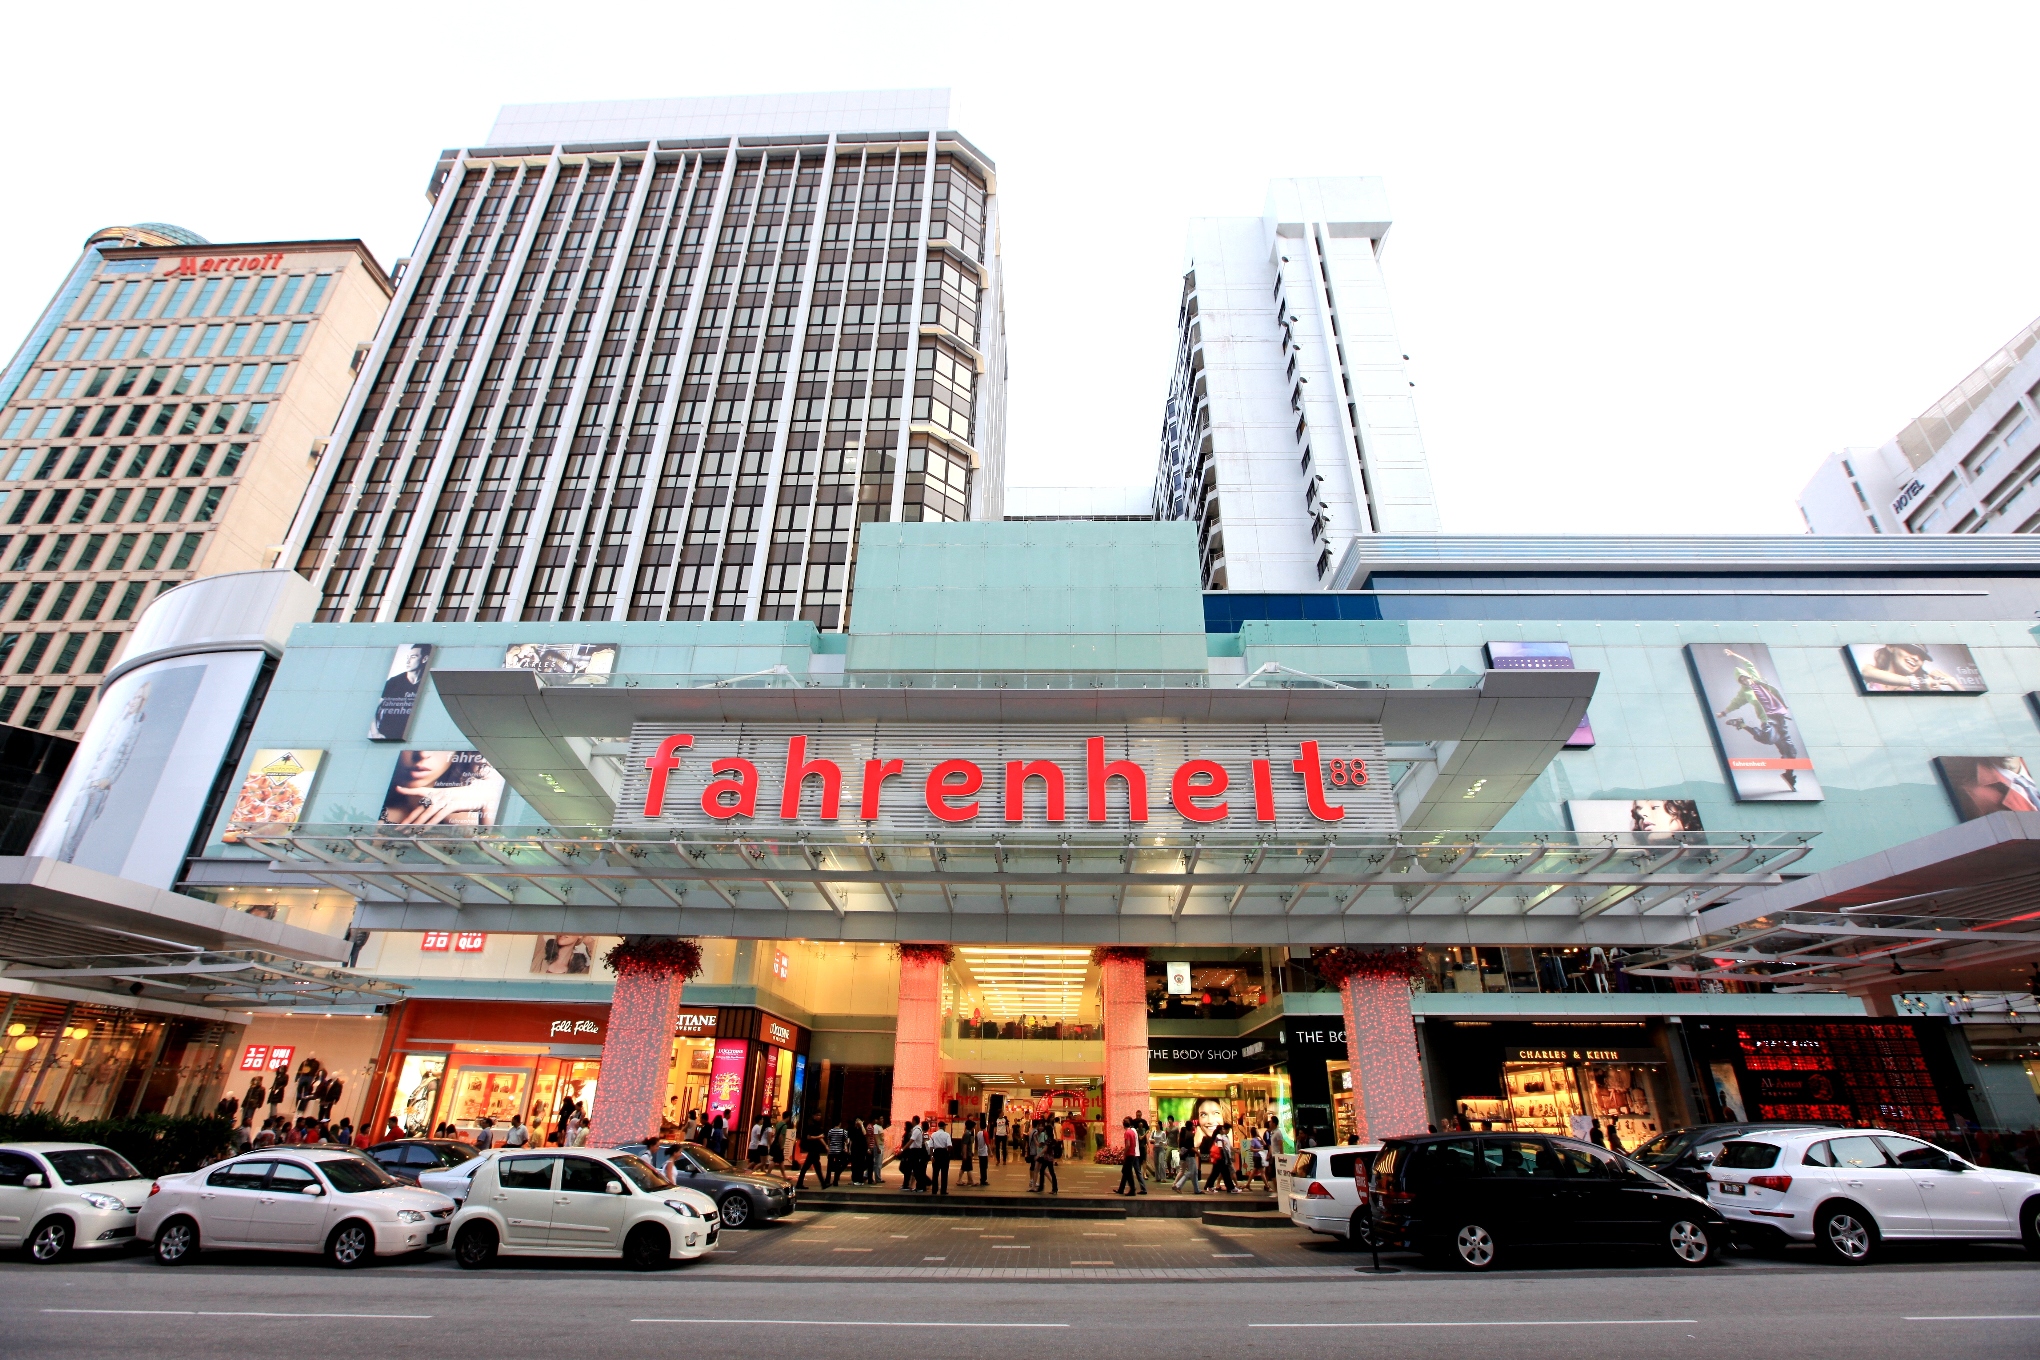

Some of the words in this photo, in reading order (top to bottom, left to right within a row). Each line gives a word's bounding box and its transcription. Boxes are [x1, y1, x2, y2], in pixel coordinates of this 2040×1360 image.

[163, 252, 283, 277] Marriott
[1892, 479, 1925, 514] HOTEL
[446, 751, 483, 763] fahre
[642, 733, 1346, 823] fahrenheit
[1330, 756, 1368, 787] 88
[458, 937, 483, 949] QLO
[551, 1020, 572, 1037] Folli
[574, 1019, 599, 1035] Follie
[1296, 1031, 1324, 1043] THE
[272, 1048, 291, 1058] UNI
[1149, 1049, 1169, 1059] THE
[1173, 1049, 1204, 1060] BODY
[1208, 1049, 1238, 1060] SHOP
[1520, 1050, 1567, 1059] CHARLES
[1573, 1051, 1581, 1060] &
[1586, 1051, 1618, 1060] KEITH
